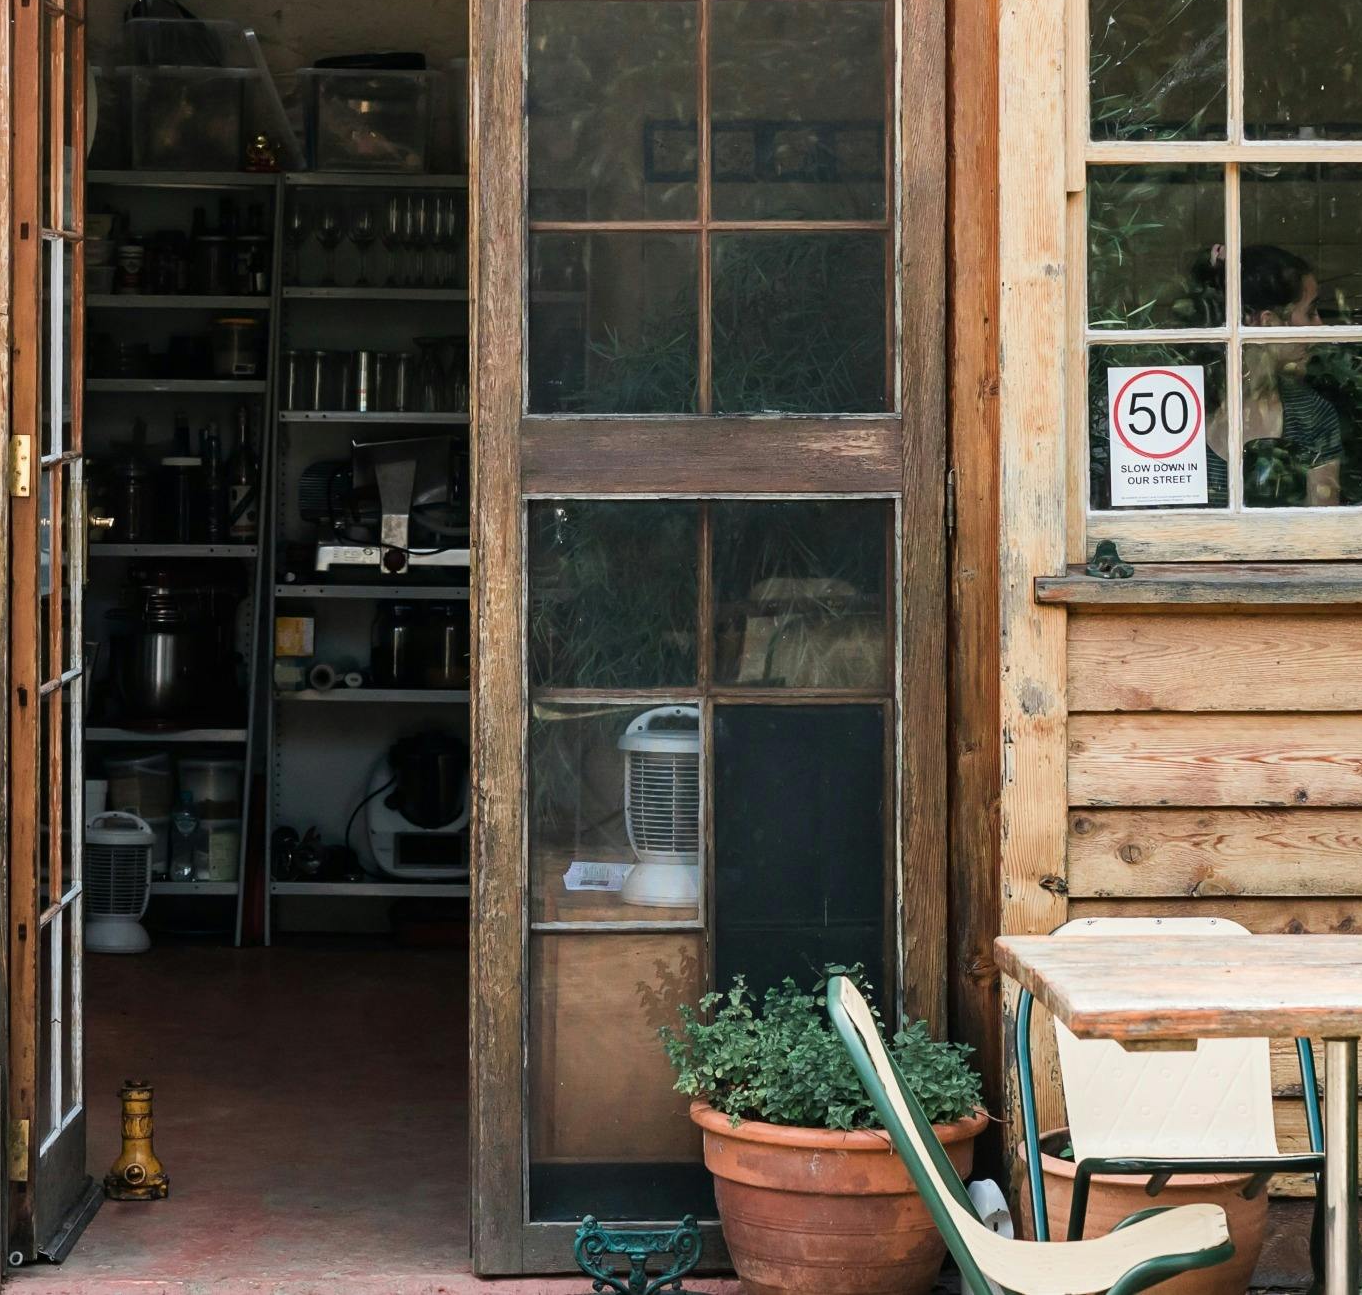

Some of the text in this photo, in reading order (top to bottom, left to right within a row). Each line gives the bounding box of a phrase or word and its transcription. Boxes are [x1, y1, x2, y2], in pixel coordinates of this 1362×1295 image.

[1128, 390, 1189, 436] 50
[1120, 462, 1198, 473] SLOW DOWN IN
[1127, 474, 1192, 485] OUR STREET
